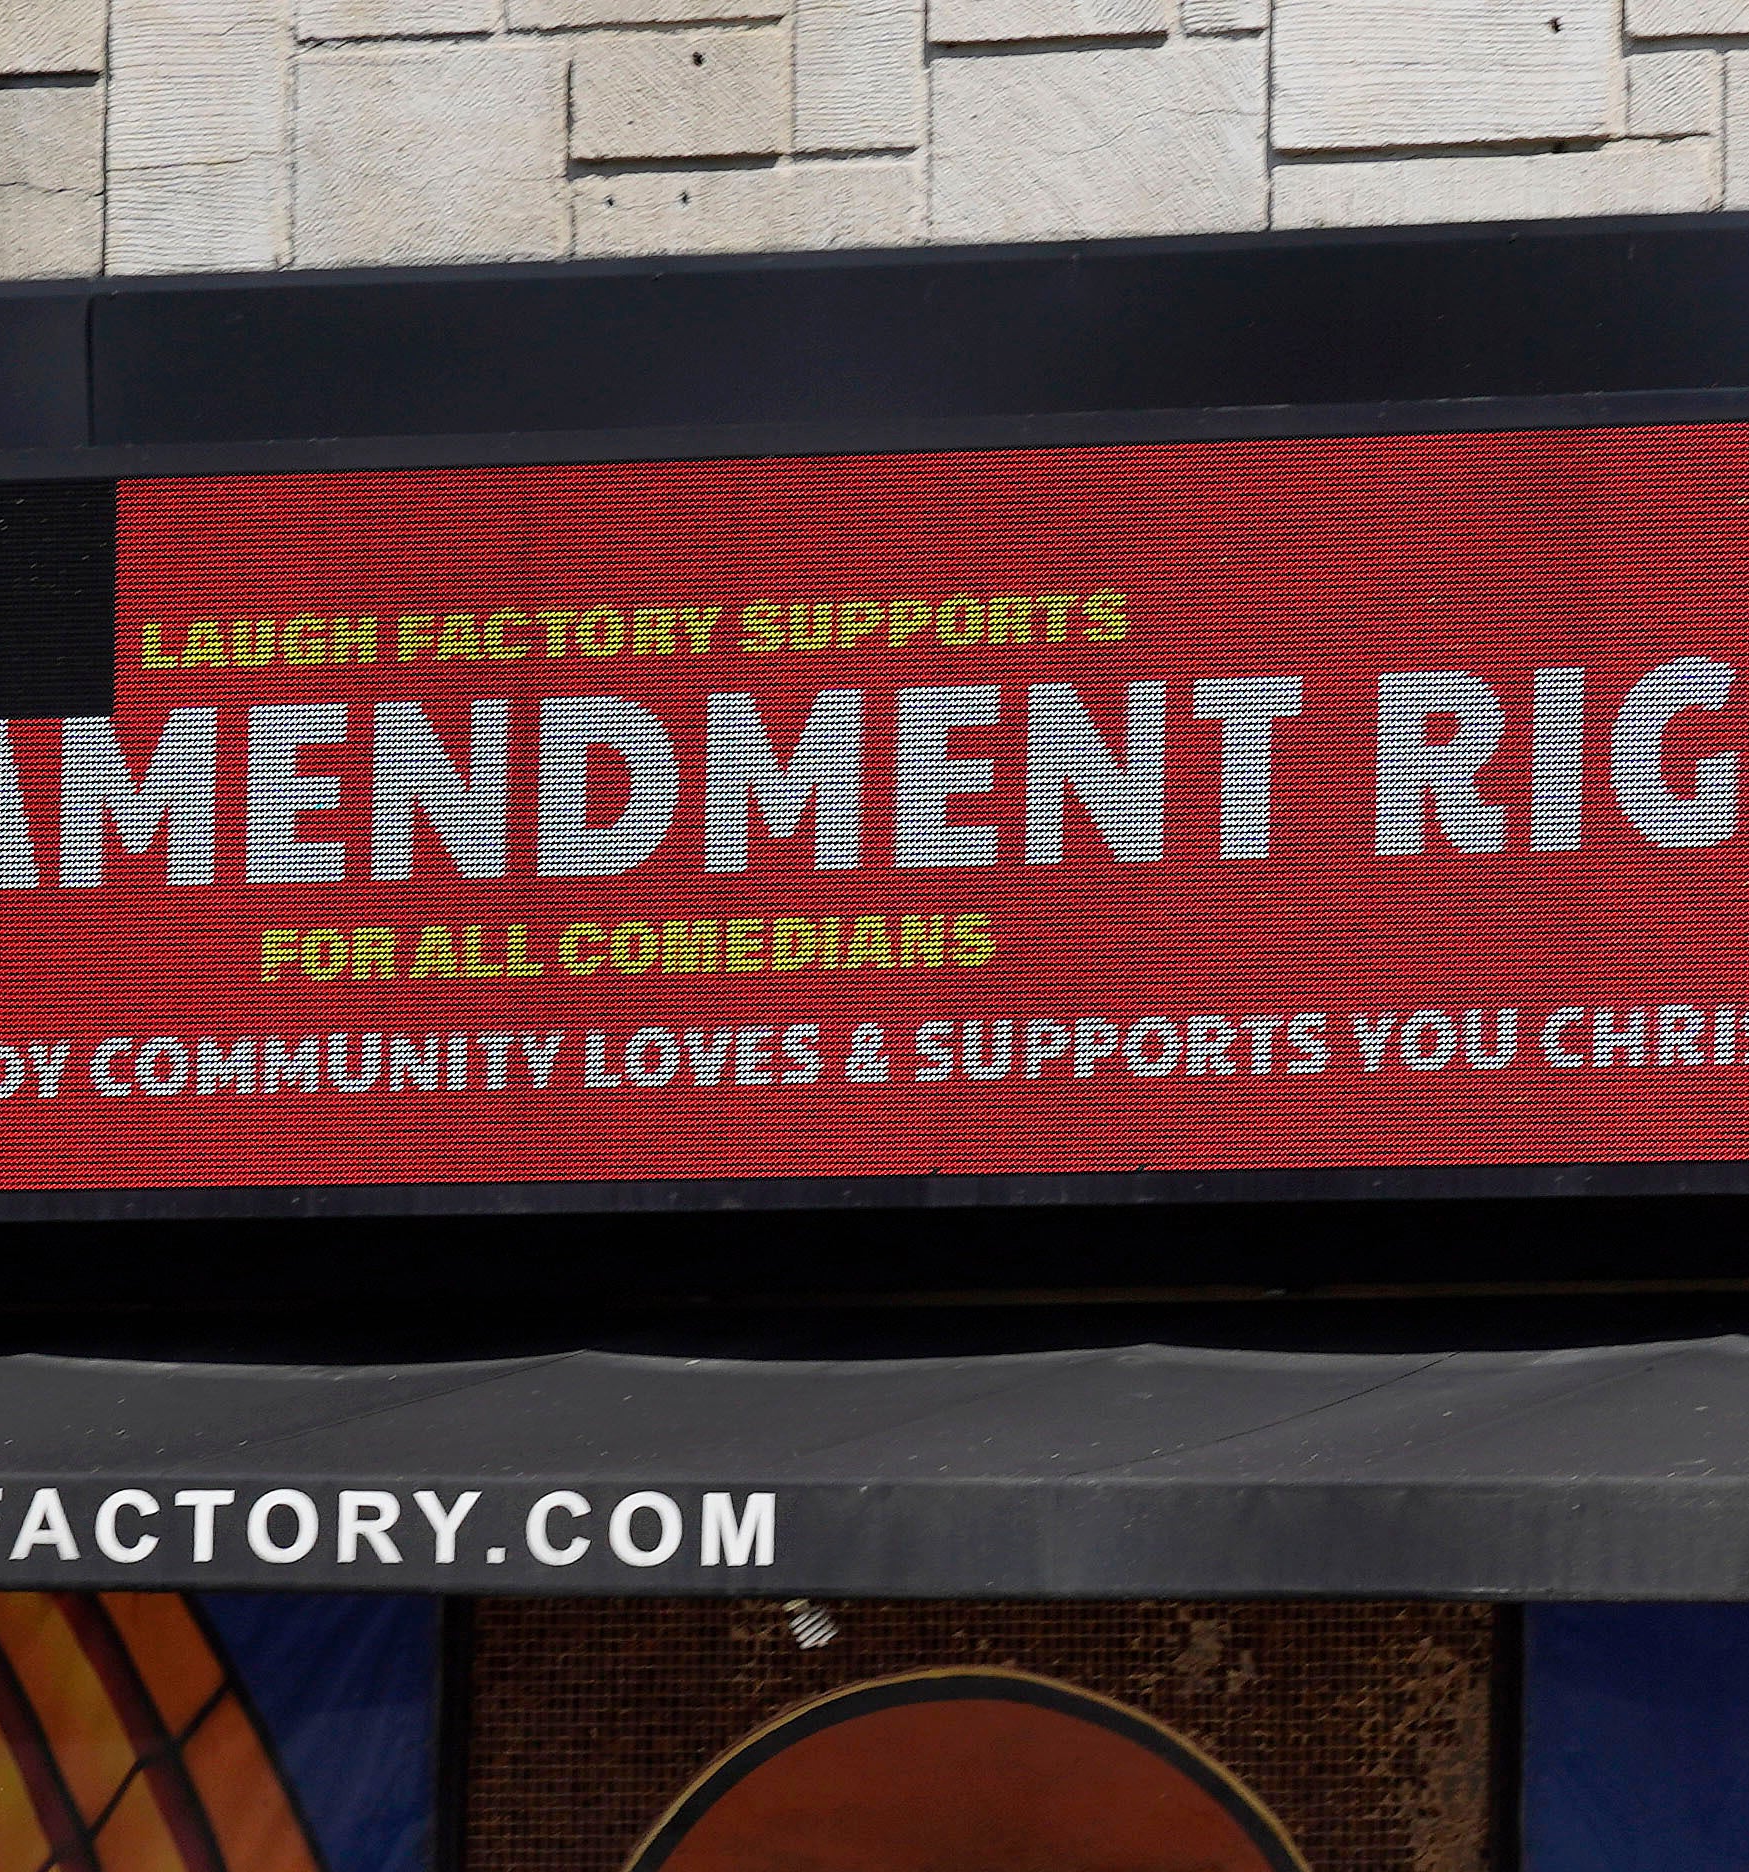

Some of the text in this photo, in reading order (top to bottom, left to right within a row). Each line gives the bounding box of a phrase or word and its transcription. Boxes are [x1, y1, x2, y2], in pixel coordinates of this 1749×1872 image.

[141, 588, 1130, 670] LAUGH FACTORY SUPPORTS
[261, 913, 998, 982] FOR ALL COMEDIANS
[87, 1031, 565, 1098] COMMUNITY
[583, 1022, 823, 1091] LOVES
[845, 1021, 890, 1084] &
[915, 1011, 1328, 1082] SUPPORTS
[1352, 1006, 1519, 1073] YOU
